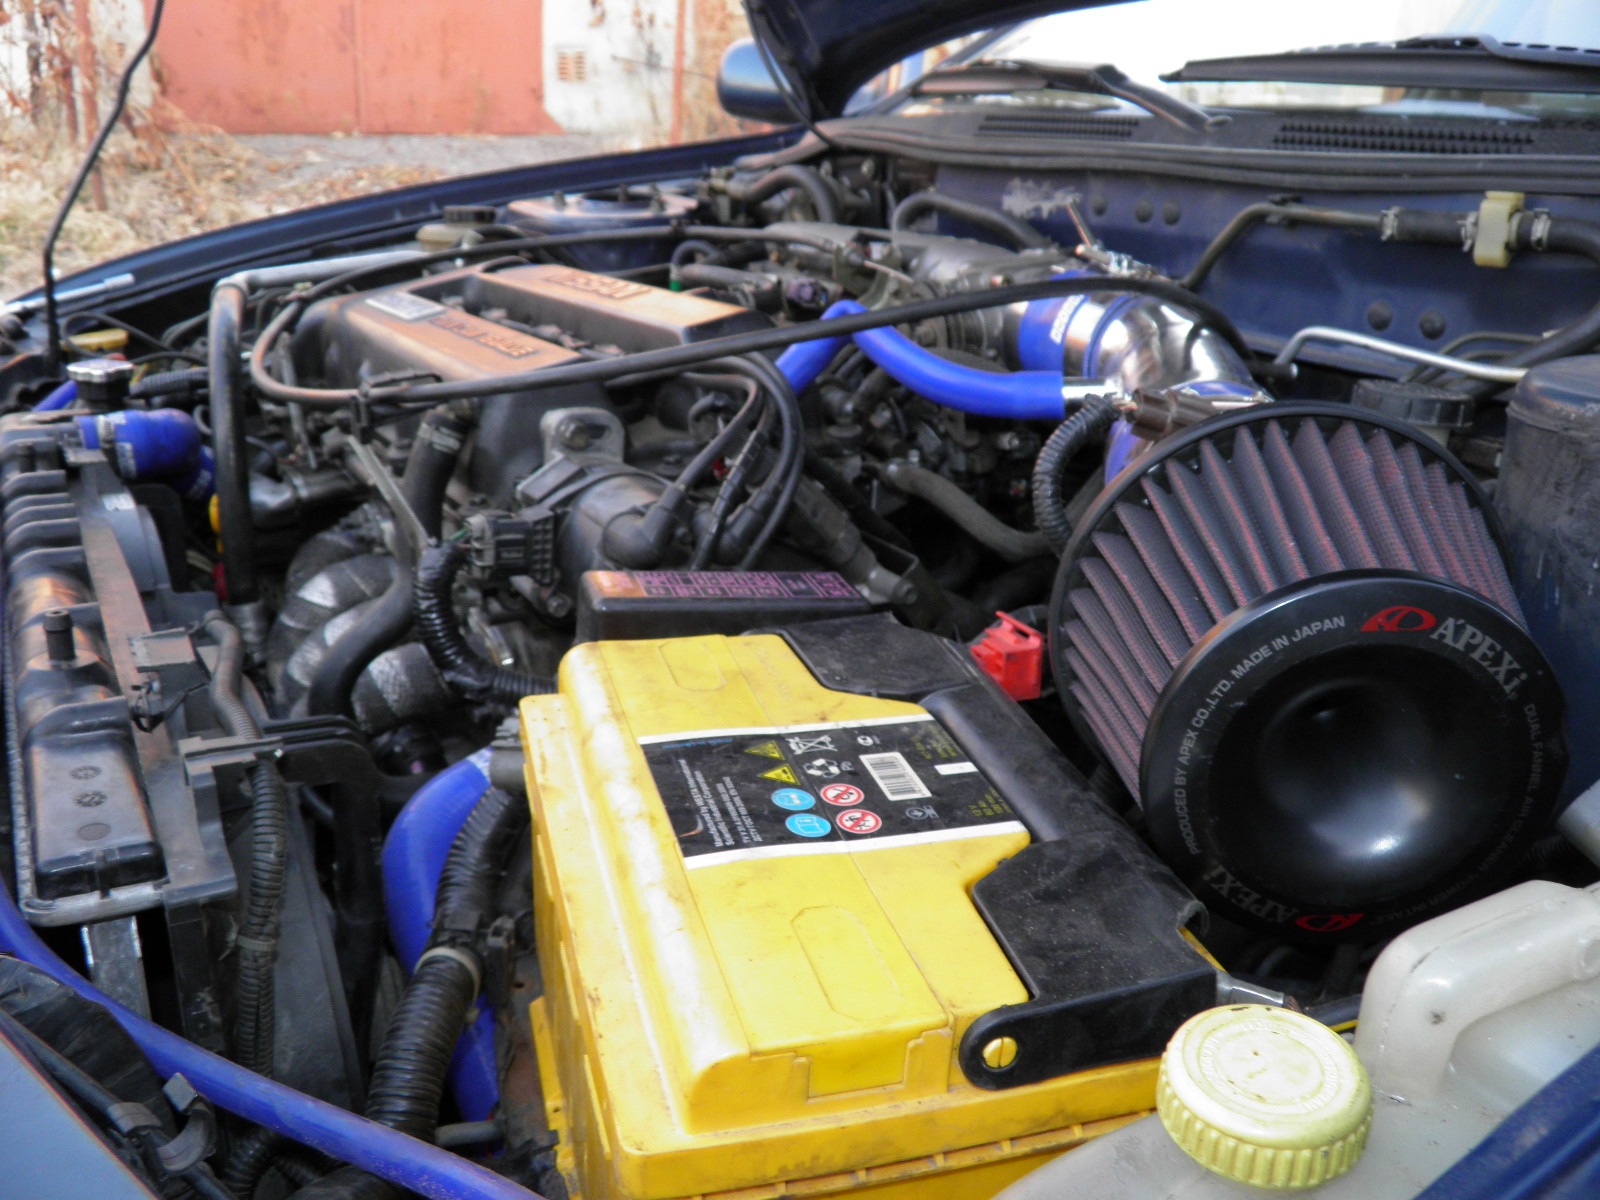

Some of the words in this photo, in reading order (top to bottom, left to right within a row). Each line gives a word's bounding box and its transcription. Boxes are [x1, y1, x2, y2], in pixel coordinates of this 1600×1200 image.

[1272, 635, 1290, 652] IN
[1291, 615, 1346, 642] JAPAN
[1231, 644, 1274, 680] MADE
[1523, 703, 1542, 741] DUAL
[1178, 729, 1200, 766] APEX
[1174, 768, 1188, 785] BY
[1527, 741, 1543, 791] FANNEL
[1174, 788, 1202, 855] PRODUCED
[1518, 796, 1535, 817] AIR
